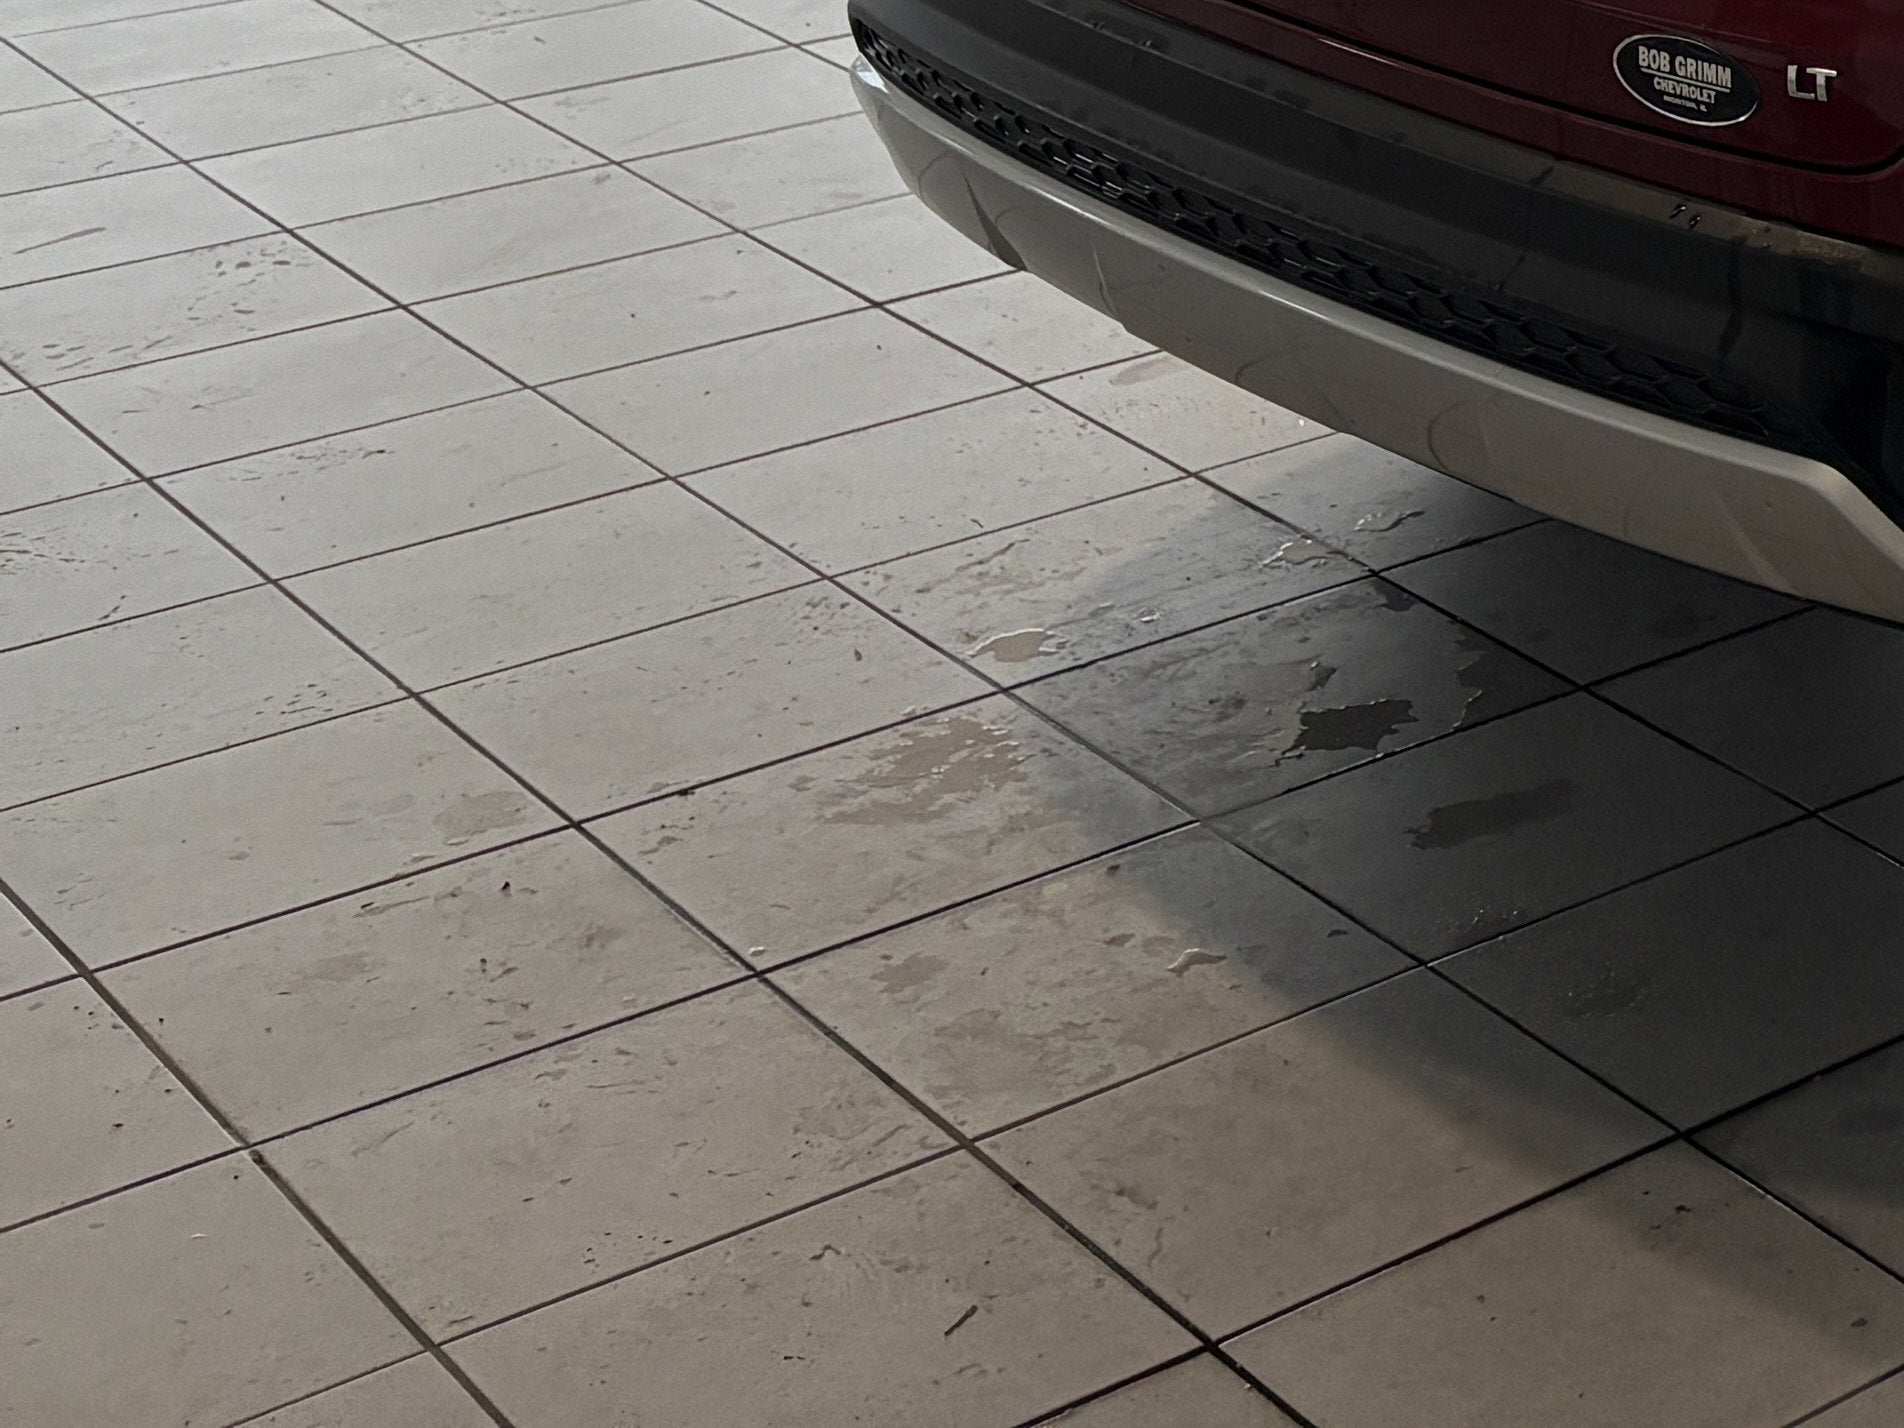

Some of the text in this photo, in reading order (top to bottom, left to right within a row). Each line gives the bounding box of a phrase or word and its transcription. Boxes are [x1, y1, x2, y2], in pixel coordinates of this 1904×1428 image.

[1638, 45, 1732, 89] BOB GRIMM
[1787, 64, 1838, 102] LT
[1653, 76, 1716, 104] CHEVROLET
